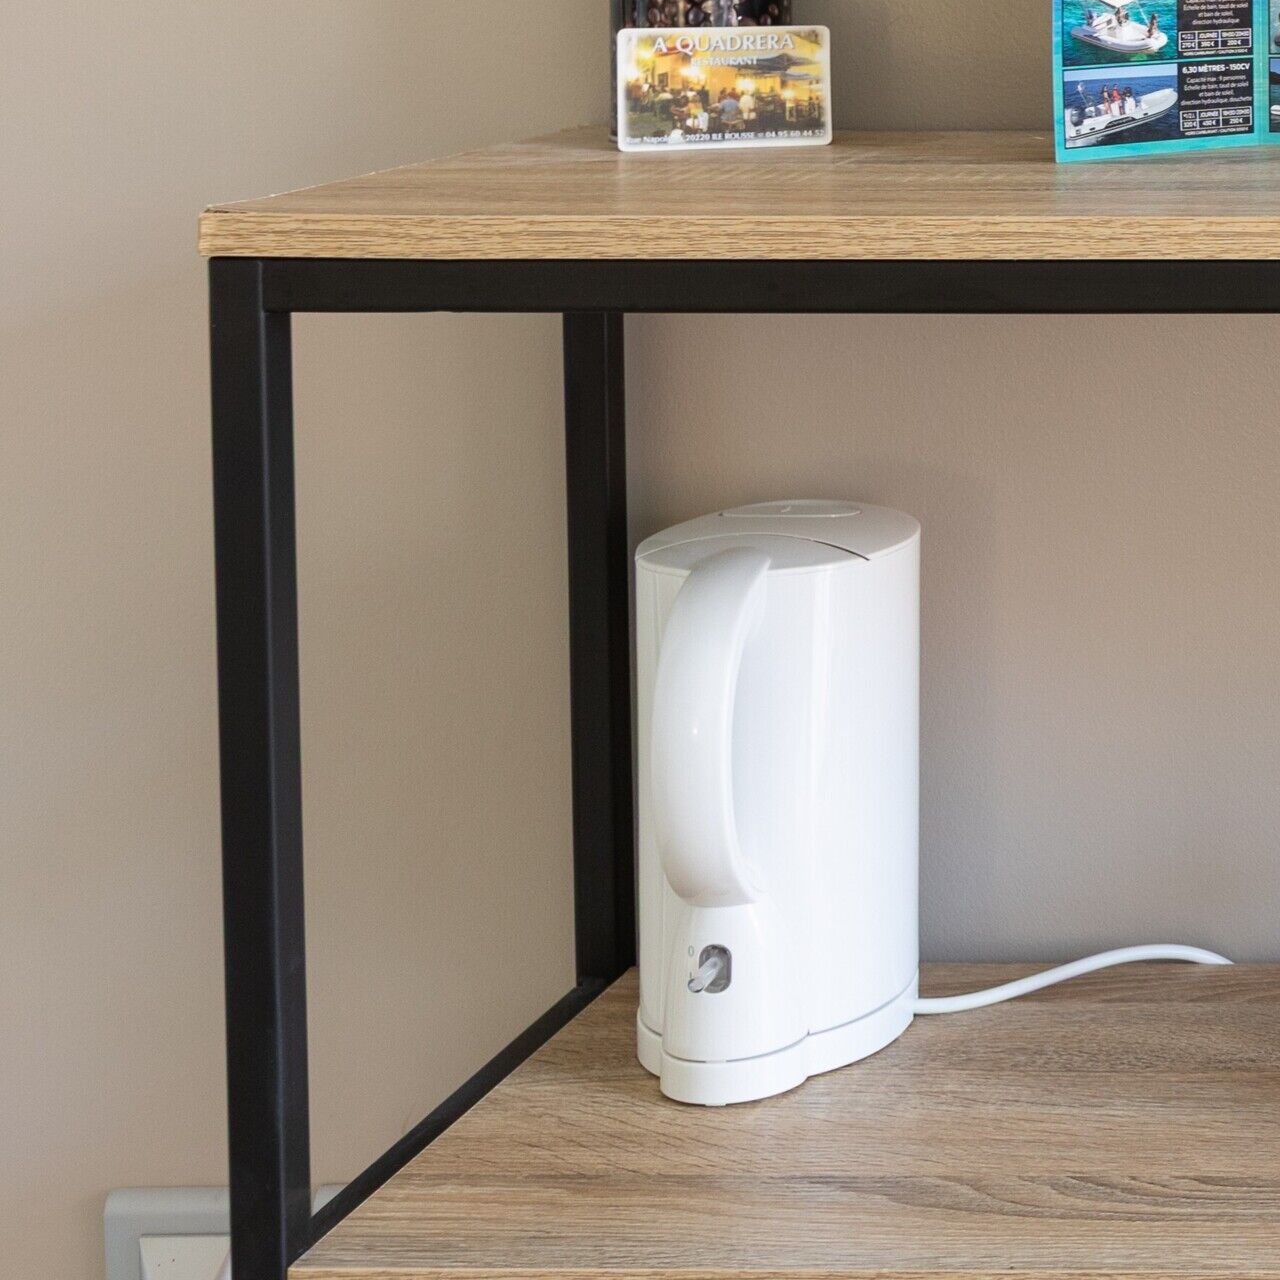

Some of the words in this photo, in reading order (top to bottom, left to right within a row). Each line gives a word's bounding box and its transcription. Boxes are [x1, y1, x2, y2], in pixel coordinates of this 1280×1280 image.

[654, 36, 668, 53] A
[676, 34, 794, 56] QUADRERA
[1198, 64, 1225, 72] MÈTRES
